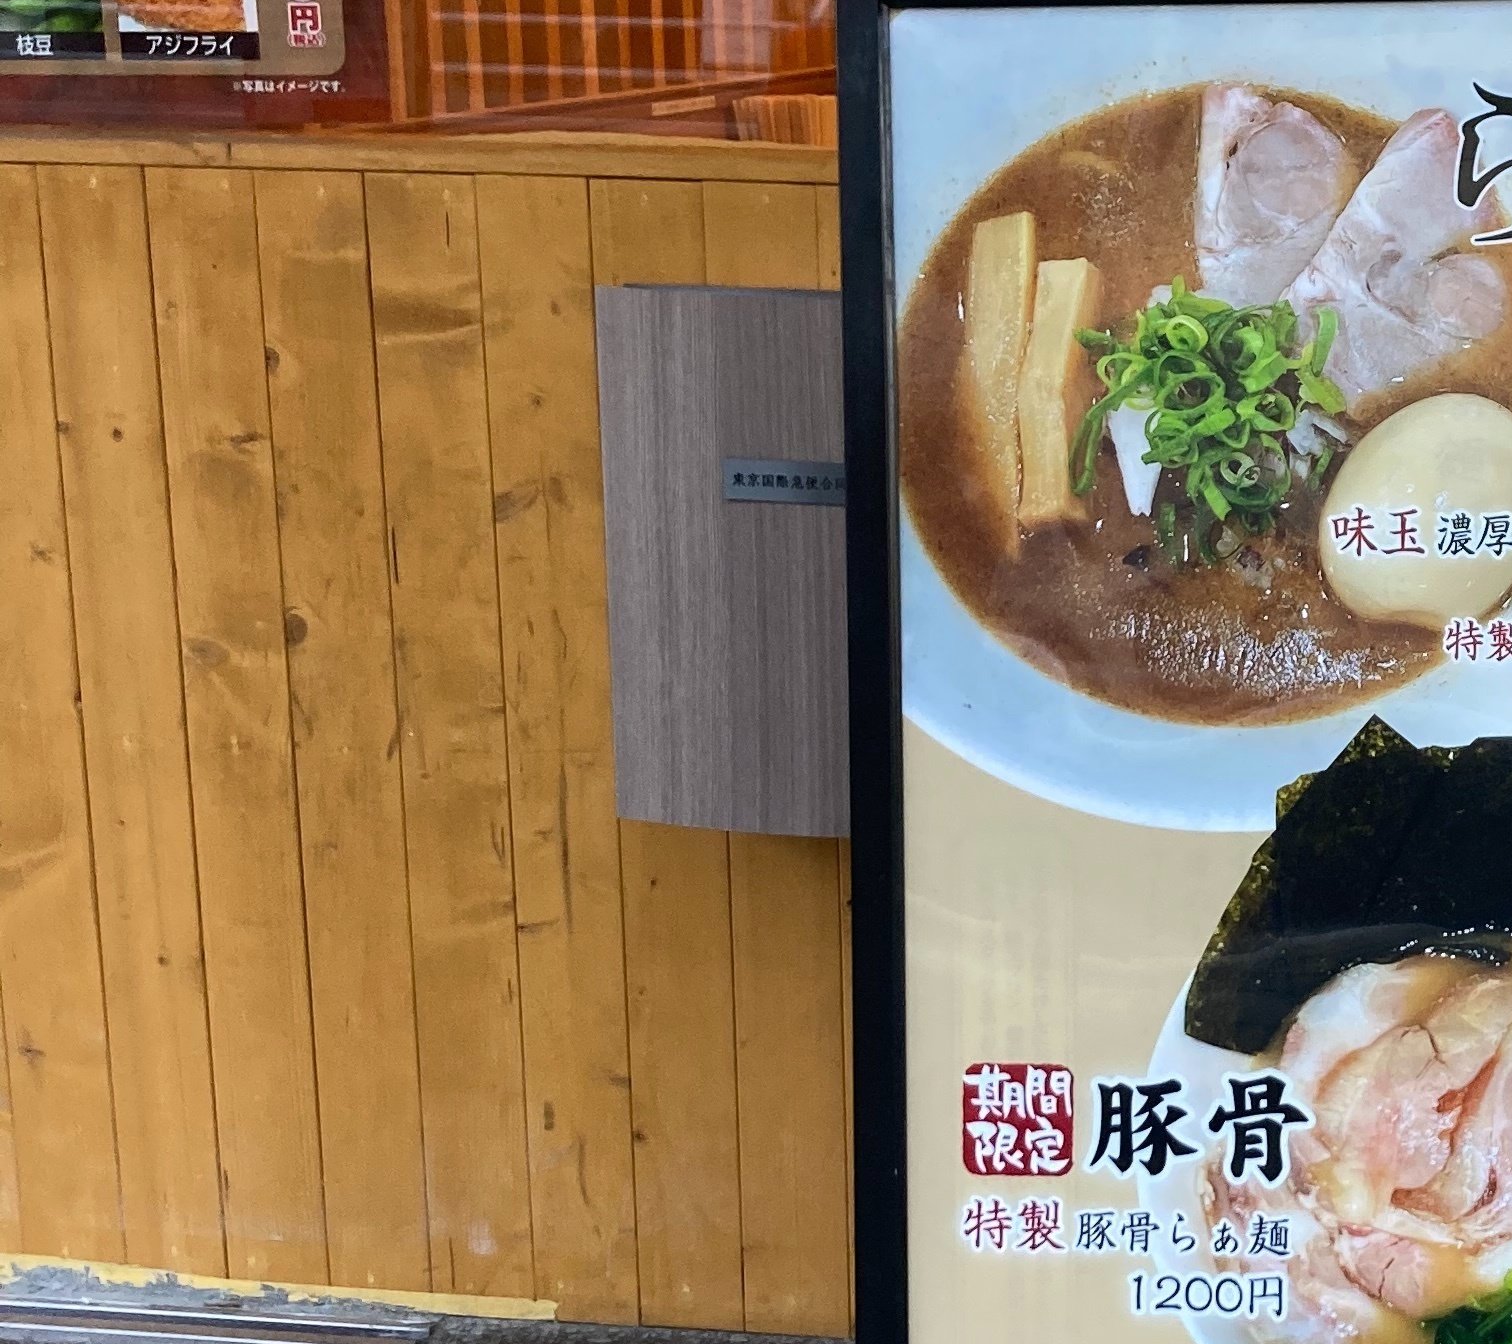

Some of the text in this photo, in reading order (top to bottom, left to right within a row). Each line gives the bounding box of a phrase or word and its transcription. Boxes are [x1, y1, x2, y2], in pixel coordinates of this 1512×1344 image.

[15, 34, 54, 56] 枝豆
[146, 35, 234, 56] アジフライ
[1332, 506, 1426, 557] 味玉
[1089, 1075, 1309, 1183] 豚骨
[964, 1199, 1290, 1256] 特製 豚骨らぁ麺
[1133, 1275, 1284, 1317] 1200円
